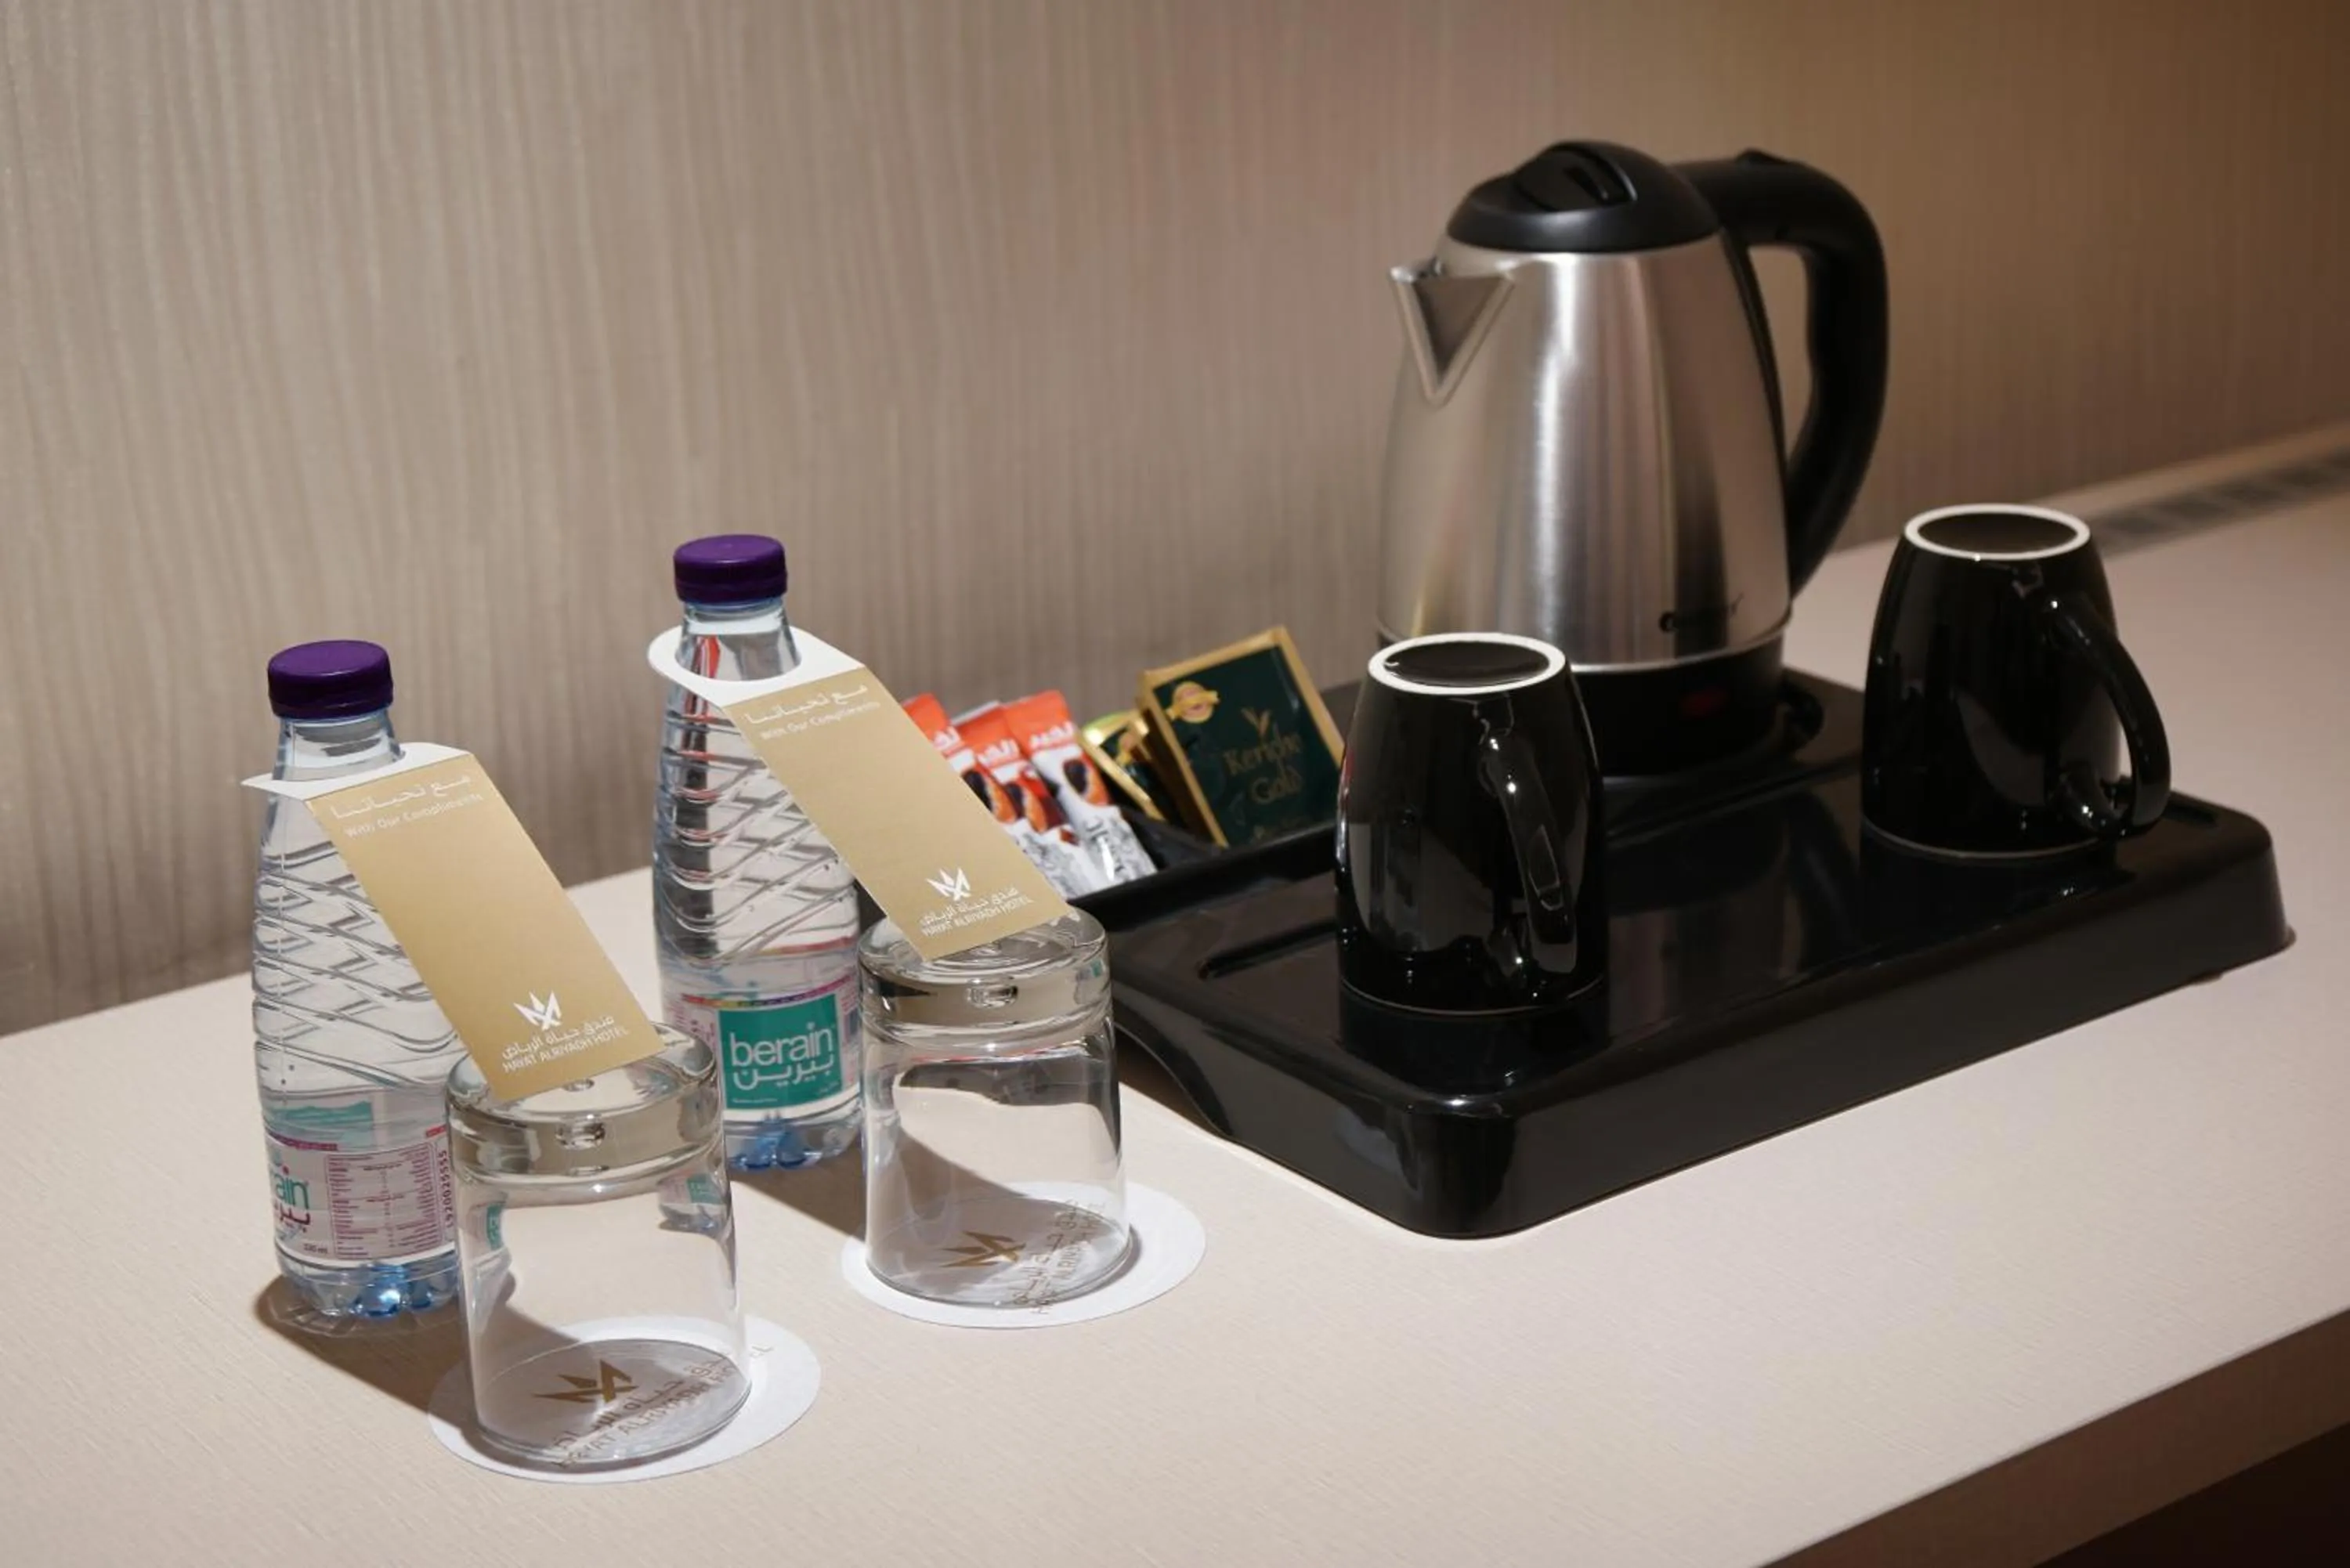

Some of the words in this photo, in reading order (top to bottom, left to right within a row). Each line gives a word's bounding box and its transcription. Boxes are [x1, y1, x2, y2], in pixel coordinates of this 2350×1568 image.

[729, 1021, 833, 1067] berain
[733, 1053, 834, 1091] بيرين
[274, 1165, 309, 1209] ain
